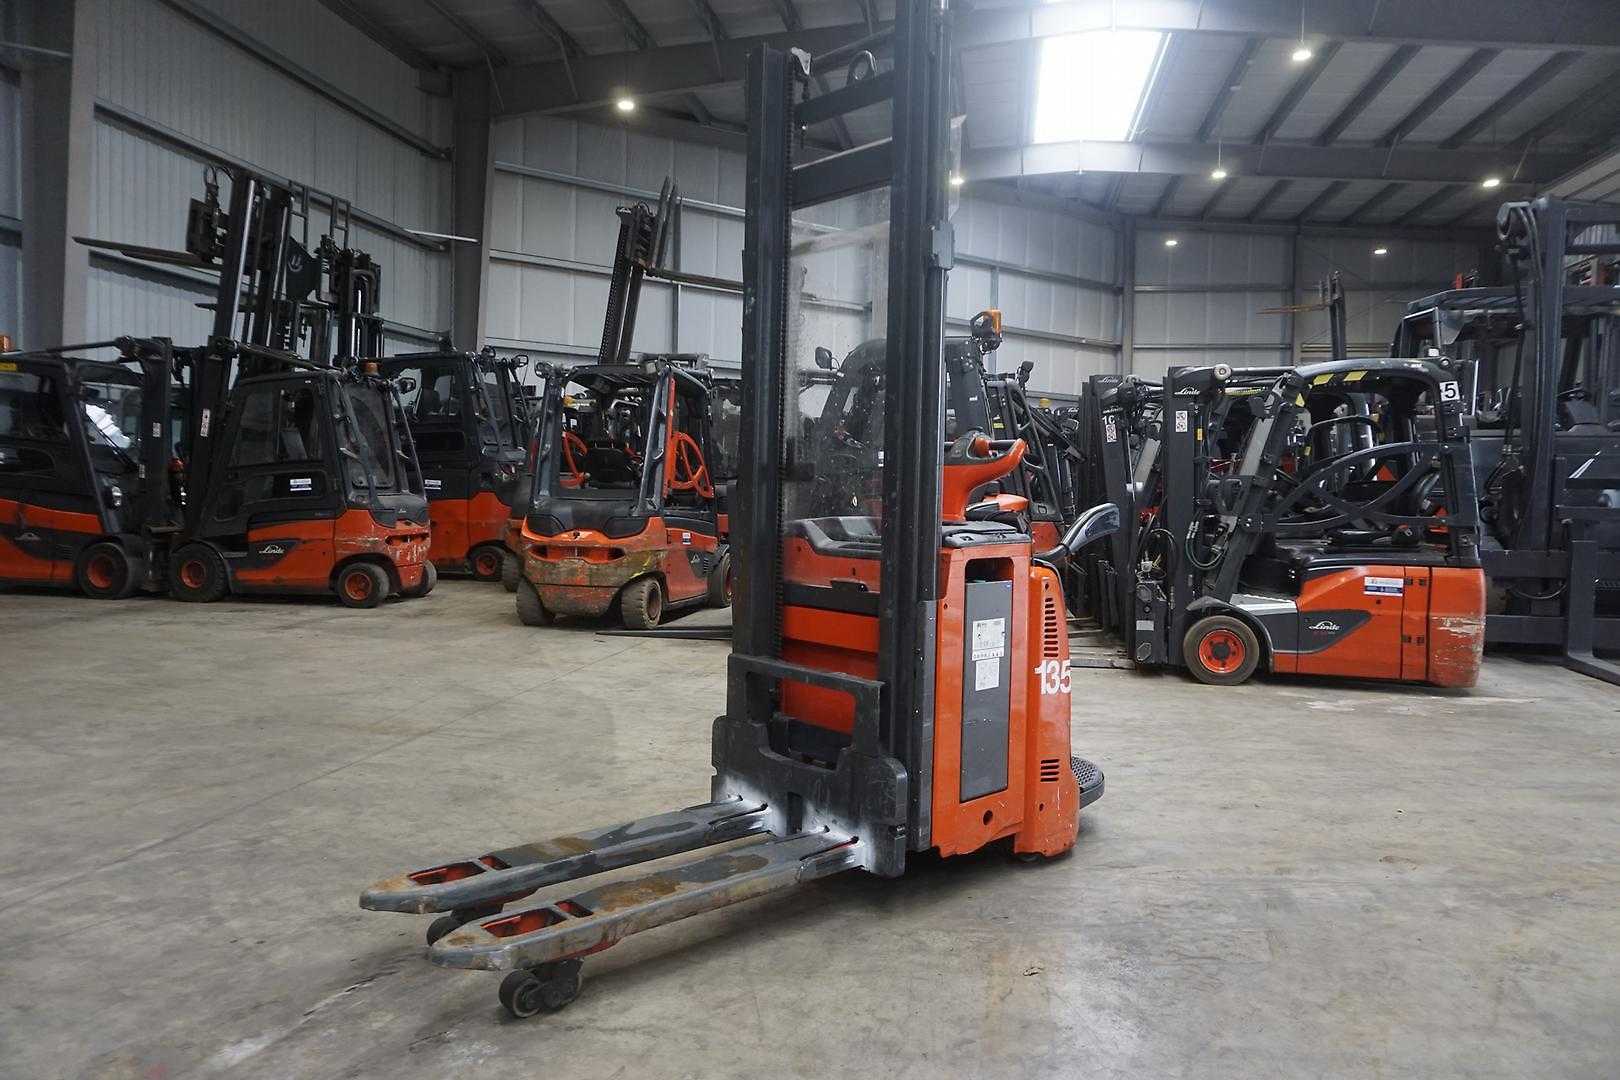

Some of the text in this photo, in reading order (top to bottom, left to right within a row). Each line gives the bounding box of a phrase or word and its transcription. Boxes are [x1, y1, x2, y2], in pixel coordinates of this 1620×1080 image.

[1174, 387, 1200, 395] Linde
[1444, 382, 1457, 399] 5
[1308, 621, 1341, 631] Linde
[1034, 659, 1072, 695] 135
